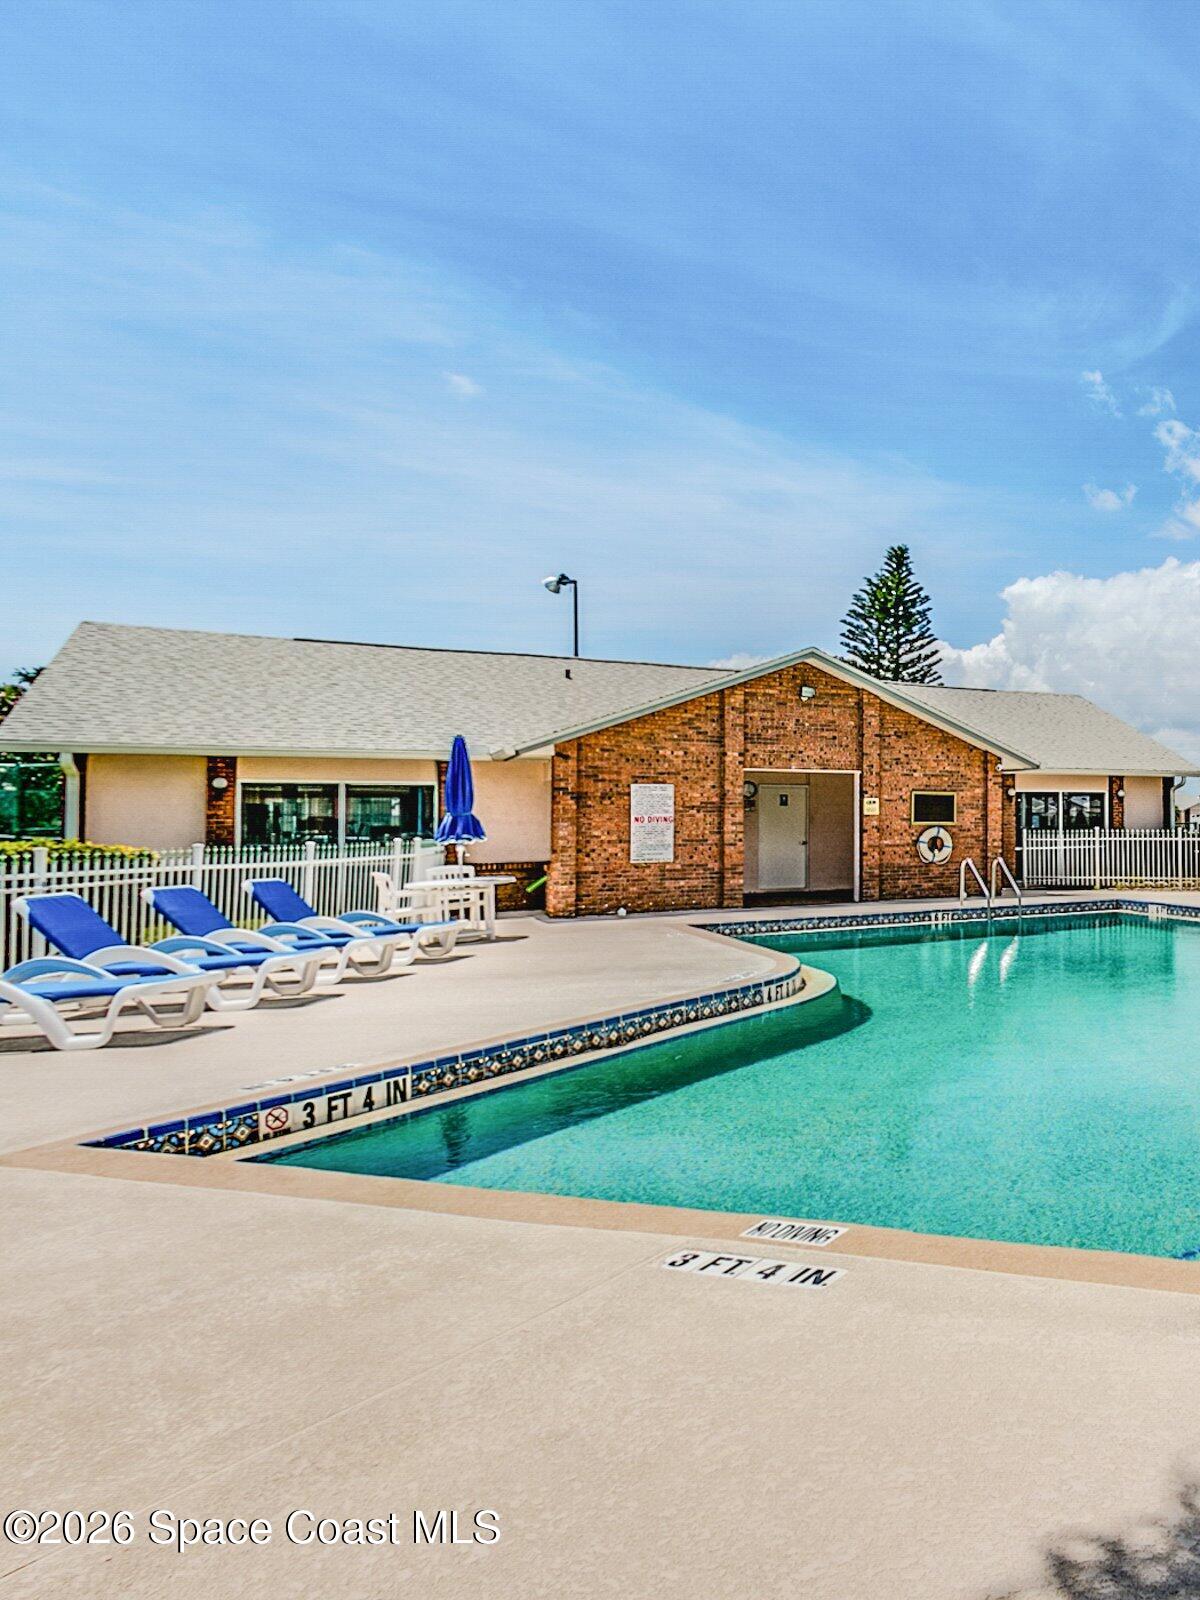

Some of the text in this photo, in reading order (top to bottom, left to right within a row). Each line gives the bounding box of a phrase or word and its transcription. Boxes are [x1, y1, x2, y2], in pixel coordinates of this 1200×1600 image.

[303, 1102, 316, 1129] 3
[327, 1092, 353, 1123] FT
[363, 1086, 375, 1112] 4
[386, 1077, 408, 1107] IN
[746, 1221, 839, 1245] NO DIVING
[668, 1253, 699, 1267] 3
[756, 1264, 787, 1280] 4
